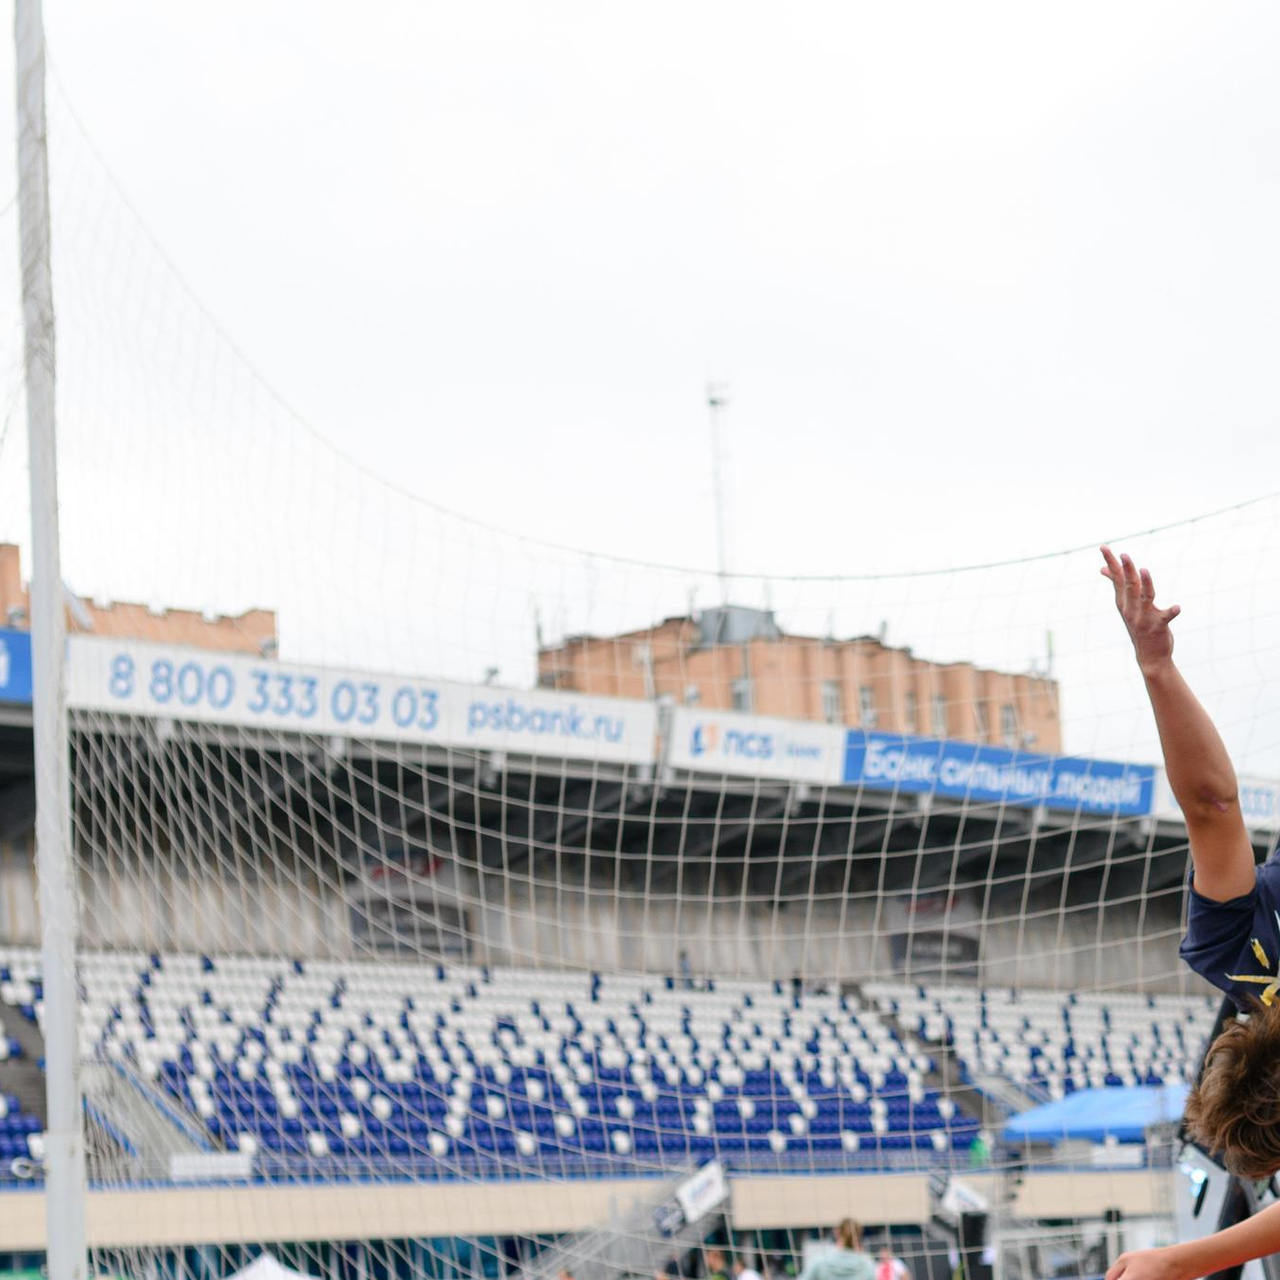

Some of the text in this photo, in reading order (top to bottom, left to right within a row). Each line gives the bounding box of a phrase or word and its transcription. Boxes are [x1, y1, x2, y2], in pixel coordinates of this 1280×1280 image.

[108, 653, 625, 743] 8 800 333 03 03 psbank.ru
